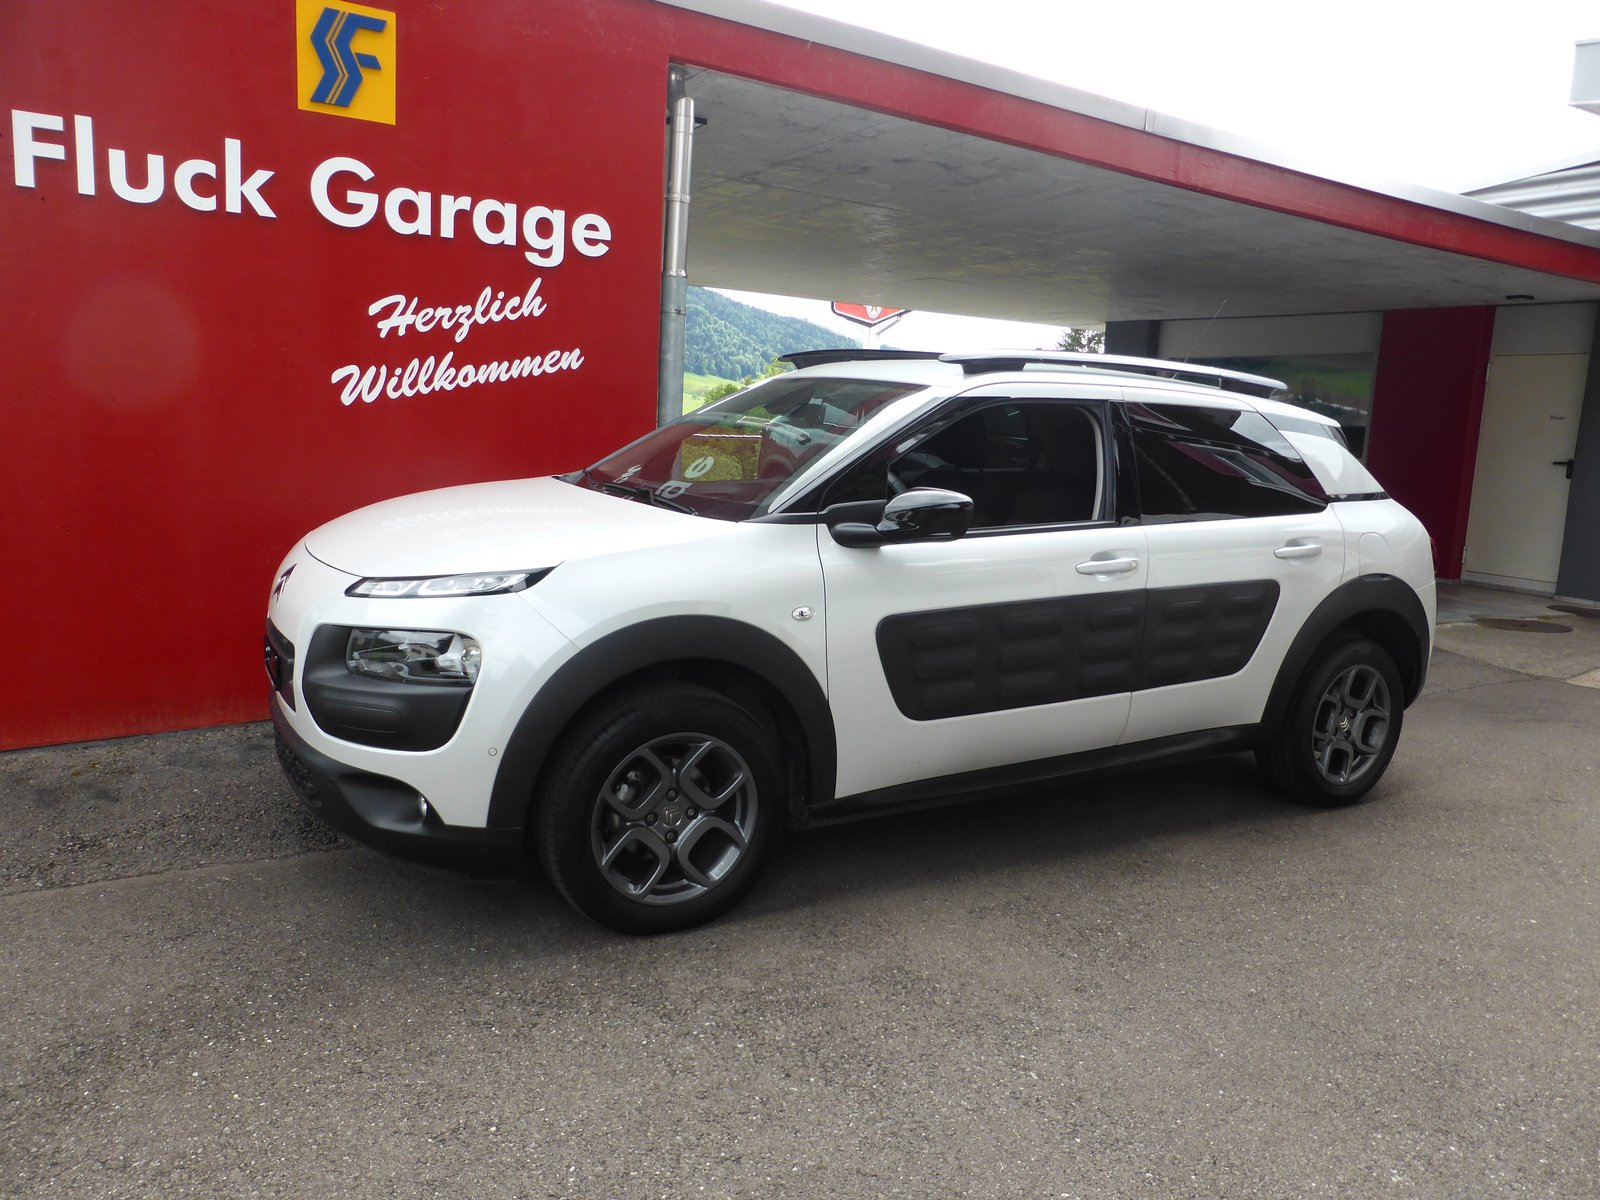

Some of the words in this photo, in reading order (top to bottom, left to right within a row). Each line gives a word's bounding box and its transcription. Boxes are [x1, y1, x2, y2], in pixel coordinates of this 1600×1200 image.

[12, 110, 277, 219] Fluck
[310, 157, 612, 268] Garage
[368, 277, 547, 343] Herzlich
[331, 347, 585, 406] Willkommen
